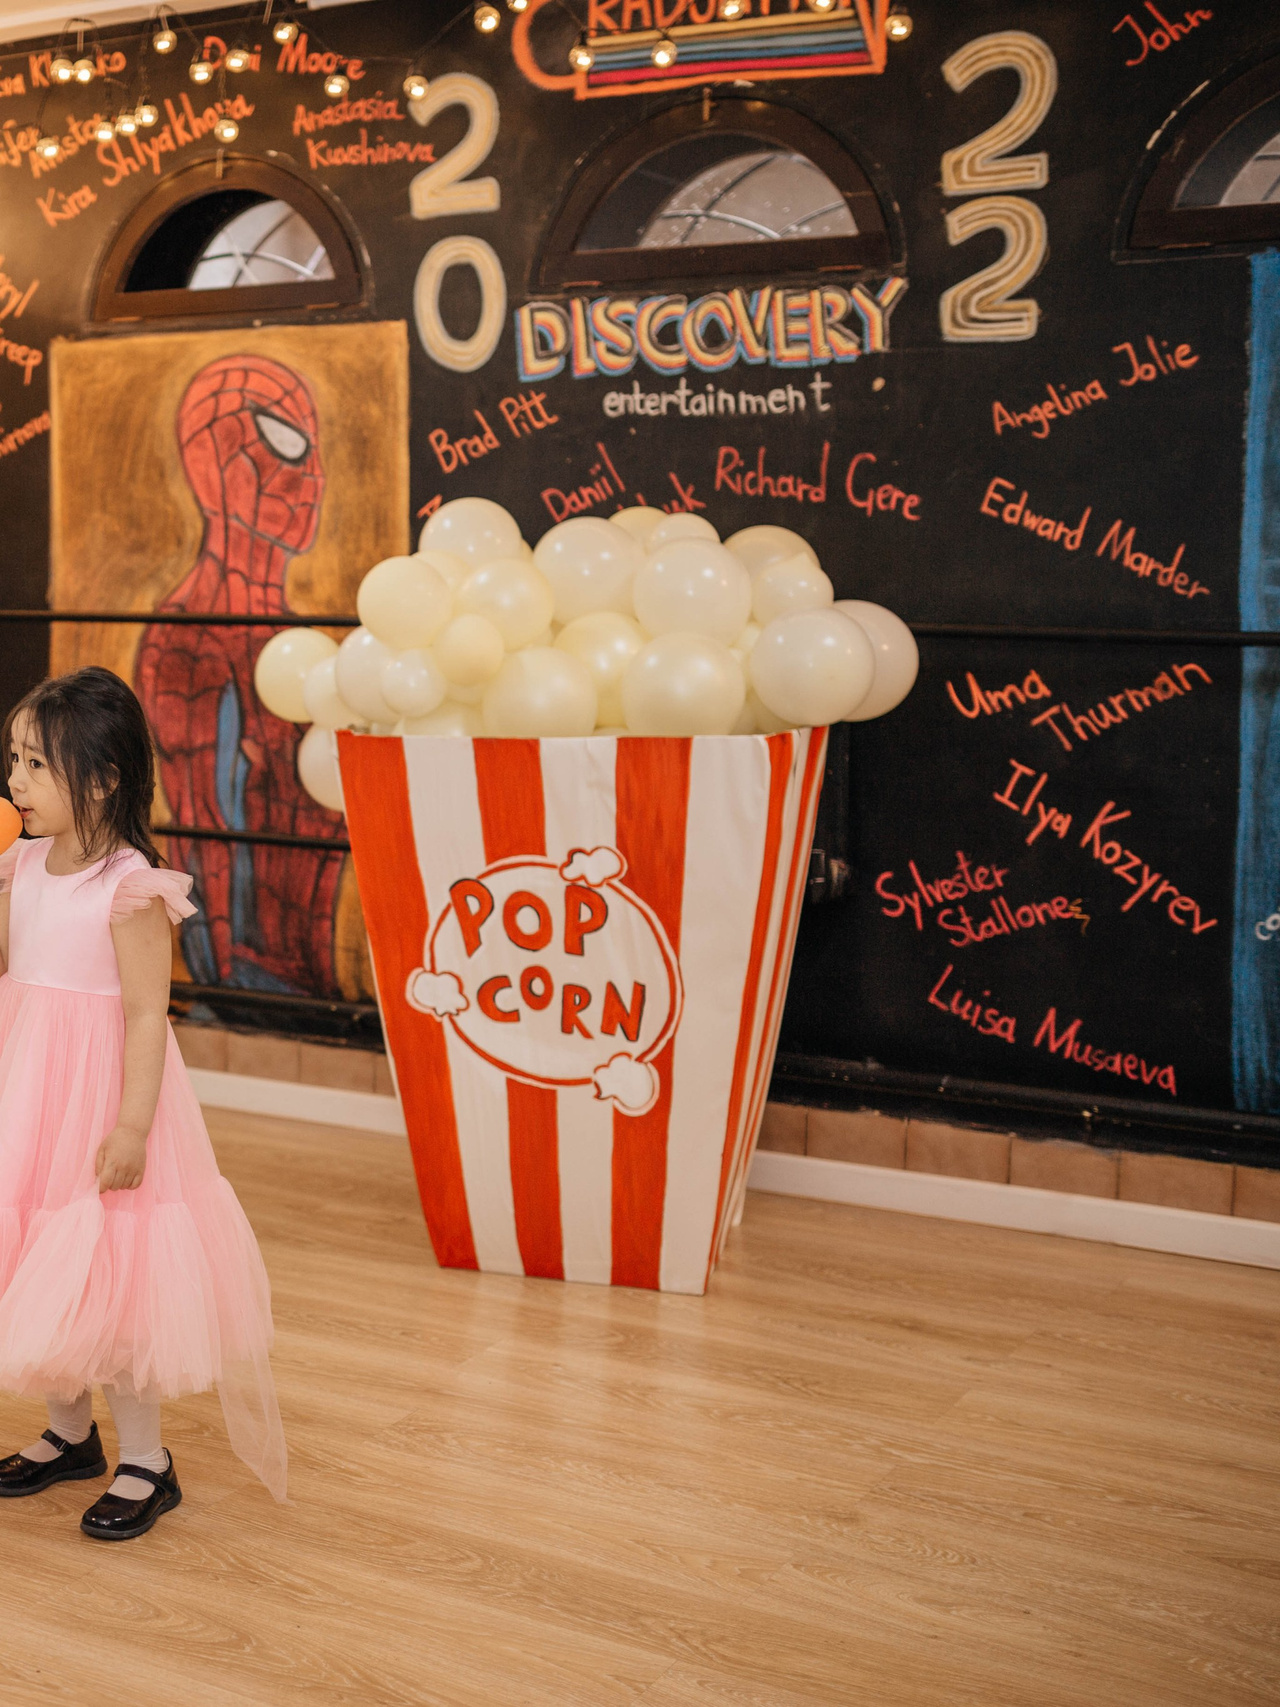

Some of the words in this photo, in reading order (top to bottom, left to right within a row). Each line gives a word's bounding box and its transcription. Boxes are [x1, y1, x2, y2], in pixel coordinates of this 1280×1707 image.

[1111, 1, 1214, 67] John
[293, 91, 406, 136] Anastasia
[36, 187, 98, 227] Kira
[515, 277, 909, 383] DISCOVERY
[602, 372, 833, 418] entertainment
[992, 380, 1108, 438] Angelina
[1112, 335, 1200, 387] Jolie
[428, 409, 501, 474] Brad
[499, 390, 560, 437] Pitt
[715, 440, 830, 502] Richard
[845, 452, 921, 521] Gere
[980, 477, 1092, 551] Edward
[1096, 519, 1210, 600] Marder
[947, 669, 1052, 719] Uma
[1030, 663, 1213, 751] Thurman
[993, 758, 1072, 846] Ilya
[1080, 801, 1218, 934] Kozyrev
[449, 878, 608, 958] POP
[875, 850, 1010, 931] Sylvester
[477, 965, 646, 1042] CORN
[928, 964, 1016, 1043] Luisa
[1033, 1007, 1178, 1096] Musaeva
